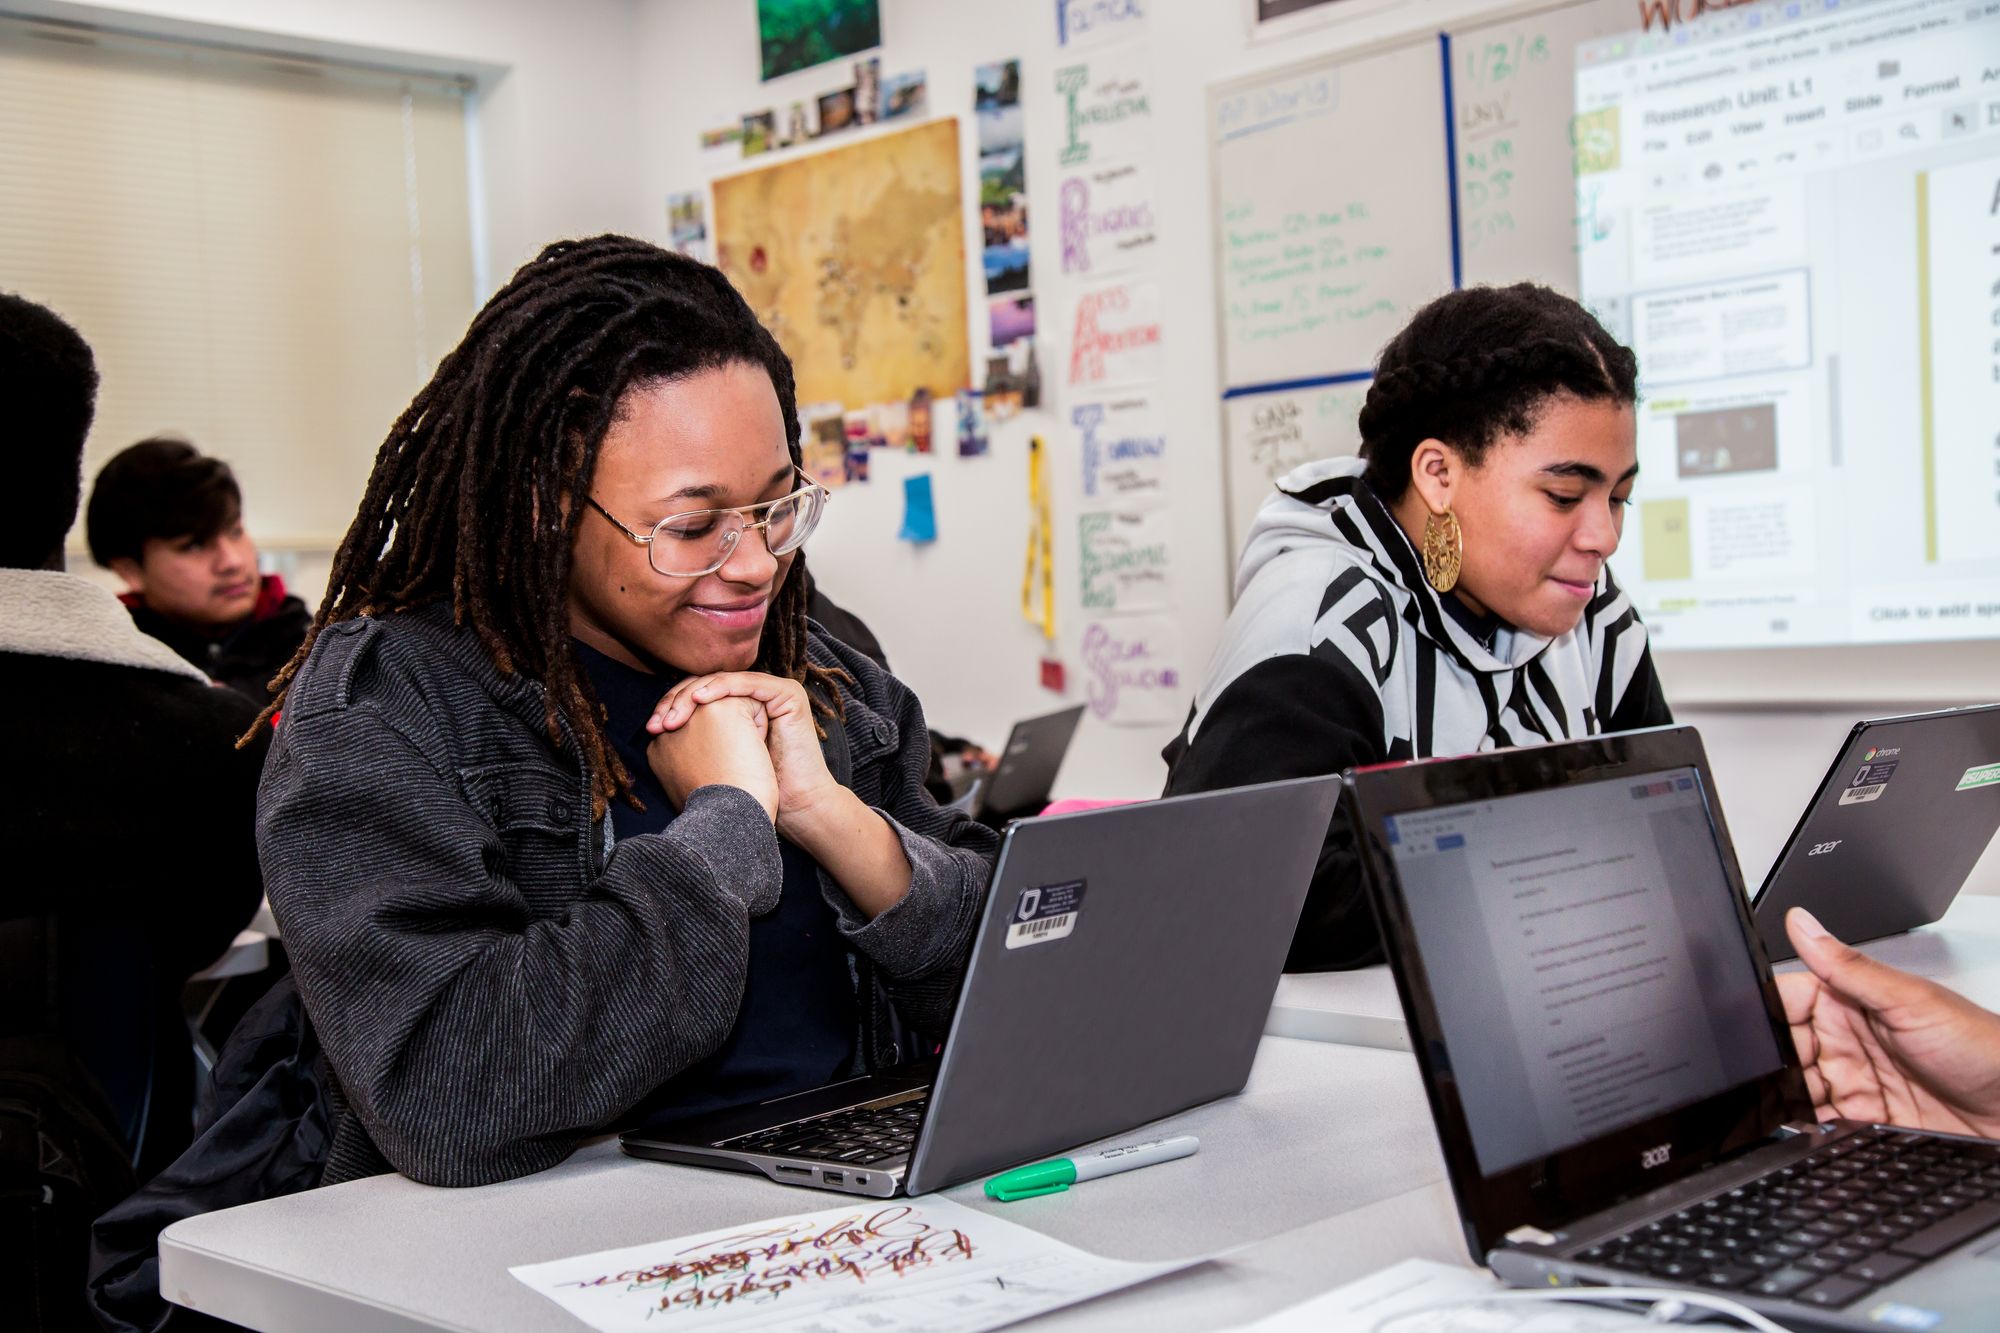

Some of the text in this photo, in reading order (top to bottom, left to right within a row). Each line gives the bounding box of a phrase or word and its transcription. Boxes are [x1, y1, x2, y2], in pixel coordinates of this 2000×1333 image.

[1644, 96, 1733, 127] Research
[1731, 120, 1765, 135] View
[1785, 105, 1826, 125] Insert
[1846, 94, 1884, 113] Slide
[1903, 76, 1961, 101] Format
[1915, 605, 1933, 620] to
[1938, 602, 1971, 618] add
[1876, 747, 1900, 758] chrome
[1808, 840, 1842, 856] acer
[1641, 1143, 1671, 1169] acer
